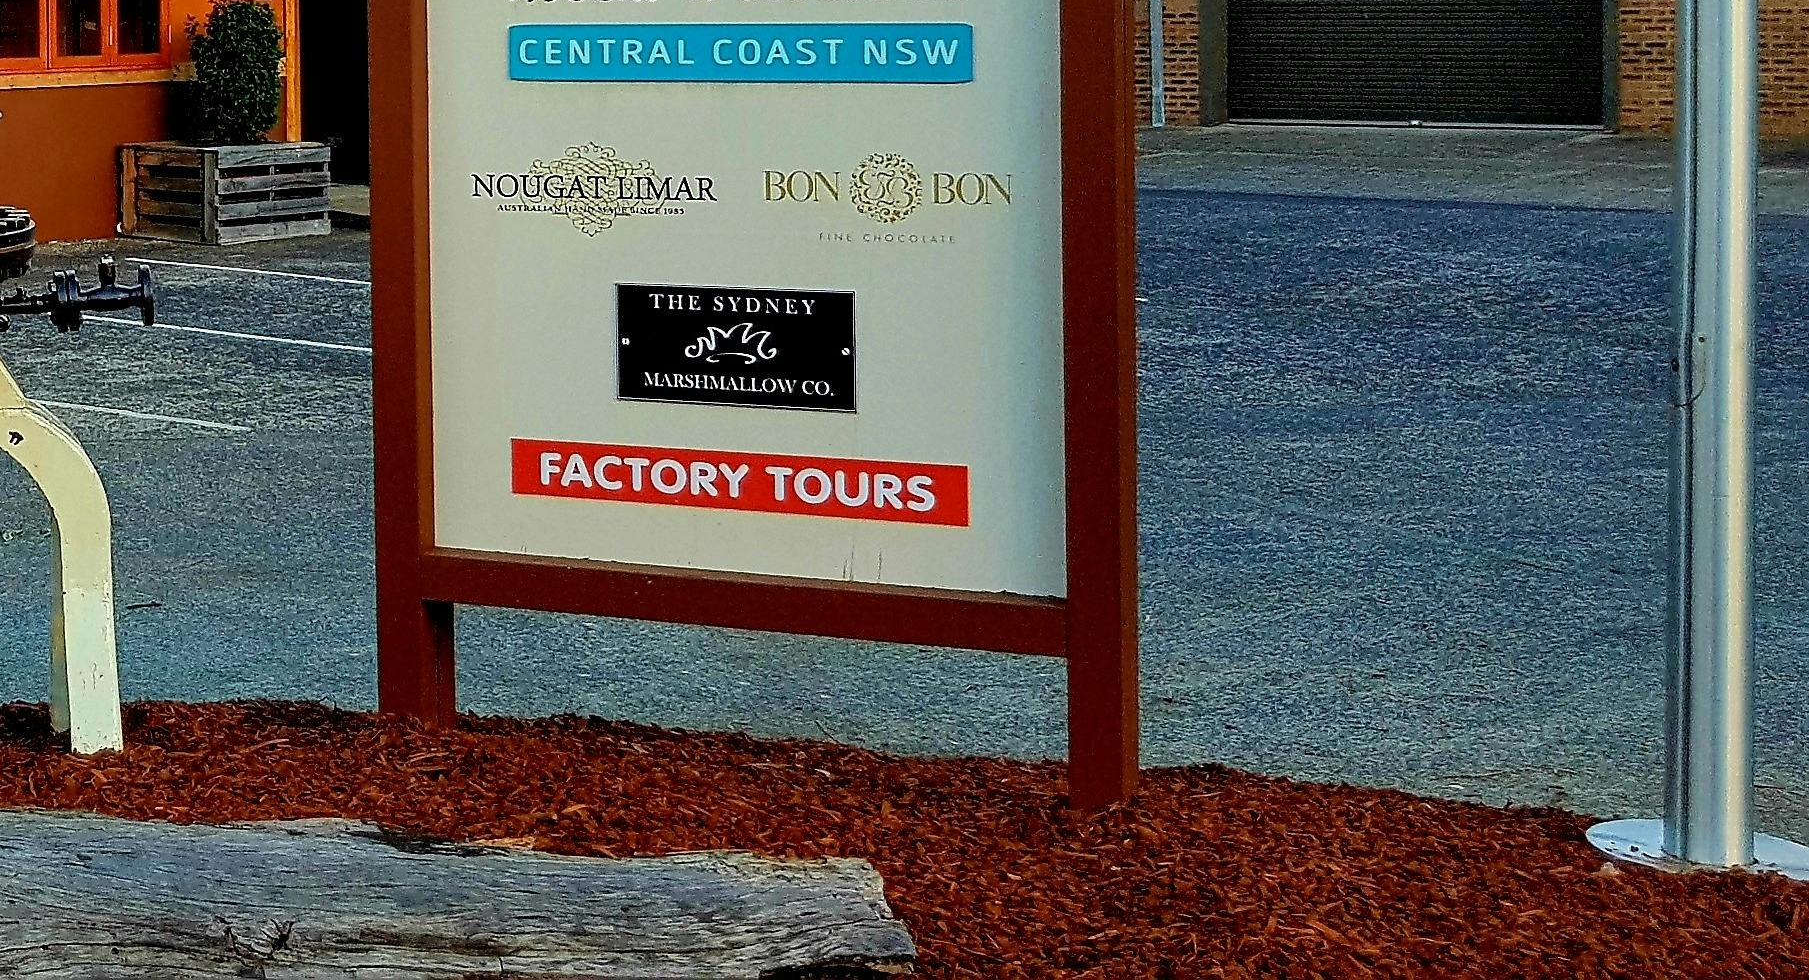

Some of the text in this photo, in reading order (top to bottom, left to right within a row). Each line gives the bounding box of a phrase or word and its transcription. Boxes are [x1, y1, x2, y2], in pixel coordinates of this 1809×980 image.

[518, 37, 960, 66] CENTRAL COAST NSW
[471, 173, 717, 202] NOUGAT LIMAR
[763, 170, 1012, 206] BON BON
[818, 232, 957, 244] FINE CHOCOLATE
[648, 293, 817, 315] THE SYDNEY
[643, 371, 835, 397] MARSHMALLOW CO.
[539, 452, 936, 512] FACTORY TOURS
